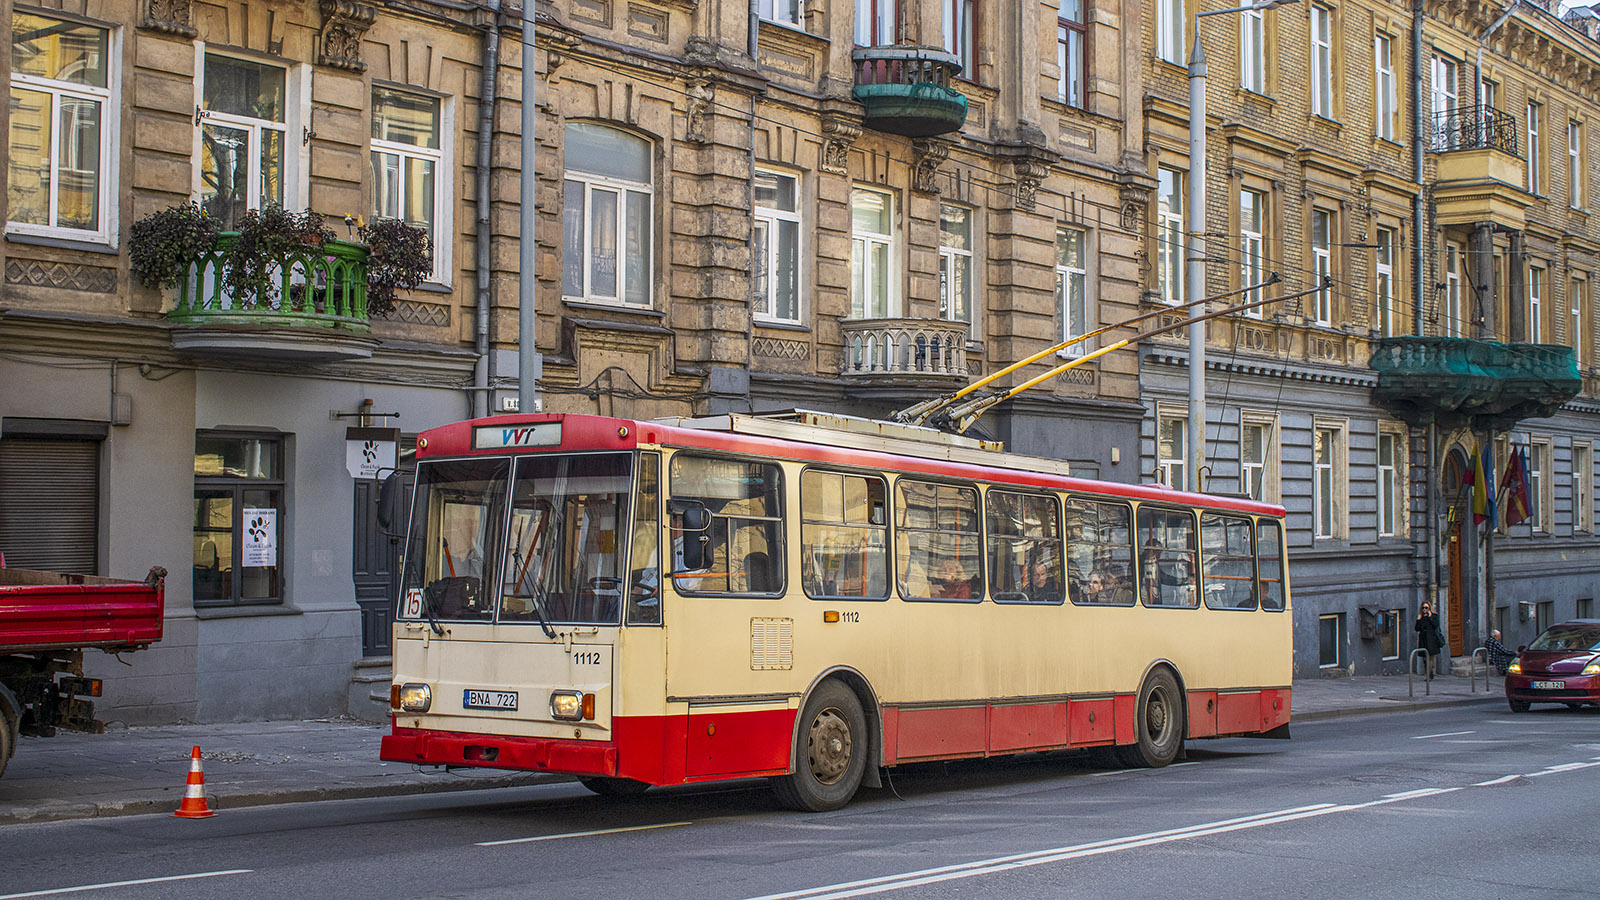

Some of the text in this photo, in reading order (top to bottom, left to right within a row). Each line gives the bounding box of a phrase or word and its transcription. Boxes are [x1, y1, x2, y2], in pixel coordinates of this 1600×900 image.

[407, 591, 420, 616] 15
[842, 611, 860, 623] 1112
[573, 652, 601, 665] 1112
[470, 692, 515, 707] BNA 722
